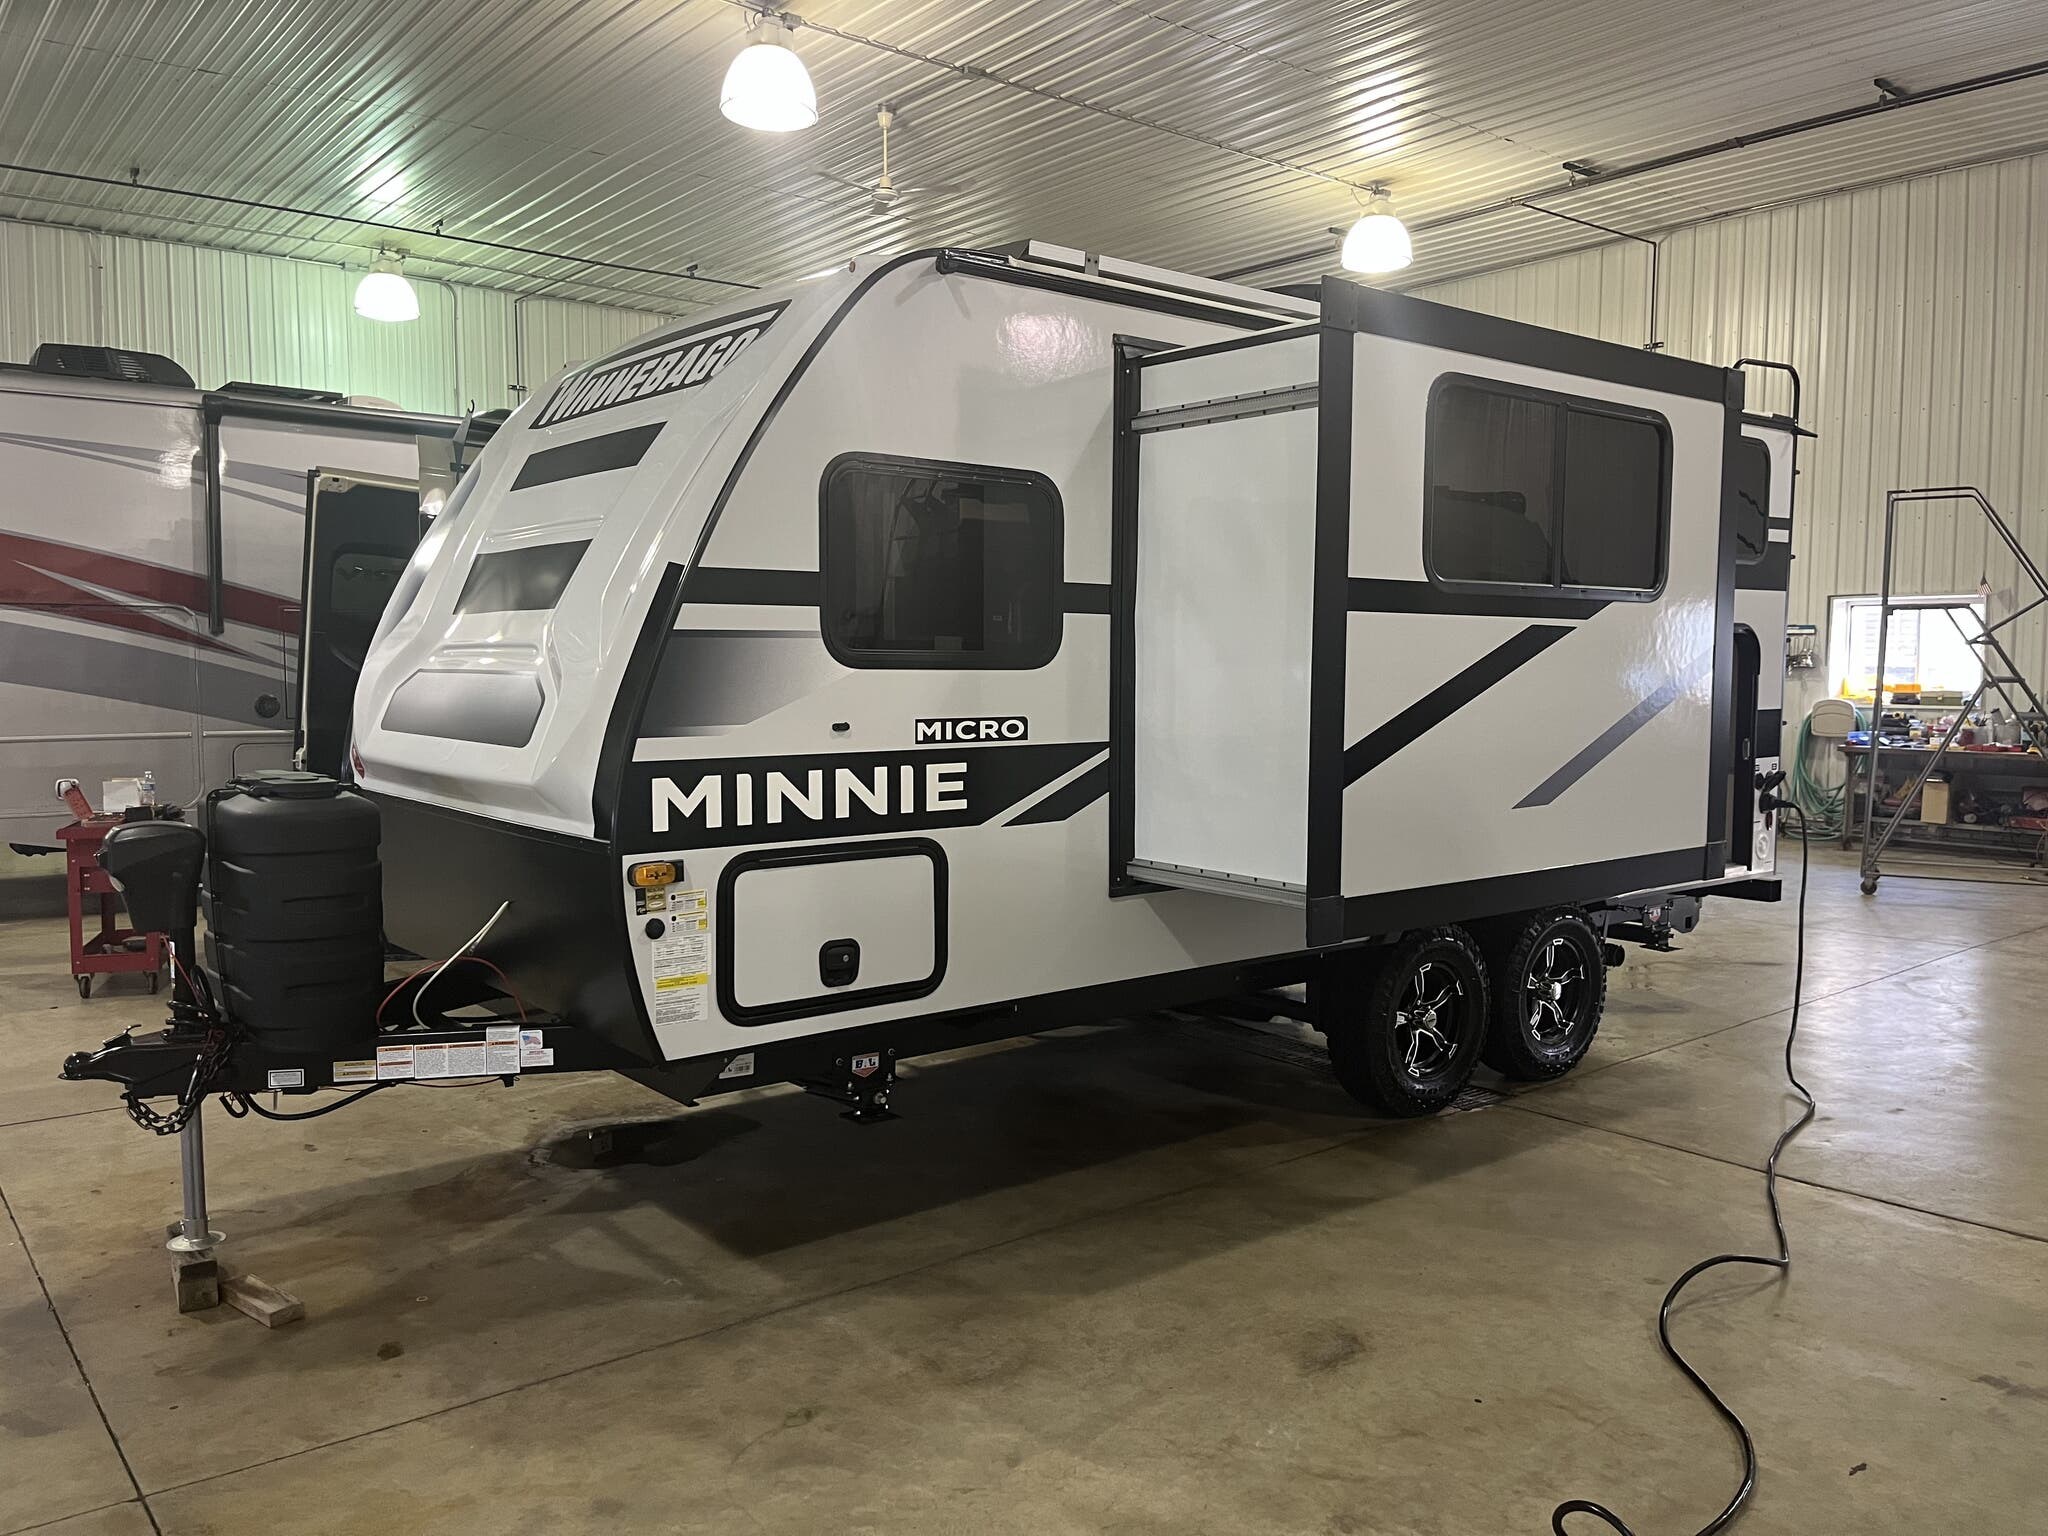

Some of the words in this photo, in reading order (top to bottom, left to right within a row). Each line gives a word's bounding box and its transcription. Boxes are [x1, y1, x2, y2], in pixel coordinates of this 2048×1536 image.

[538, 328, 760, 426] WINNEBAGO
[917, 718, 1025, 742] MICRO
[651, 762, 968, 833] MINNIE
